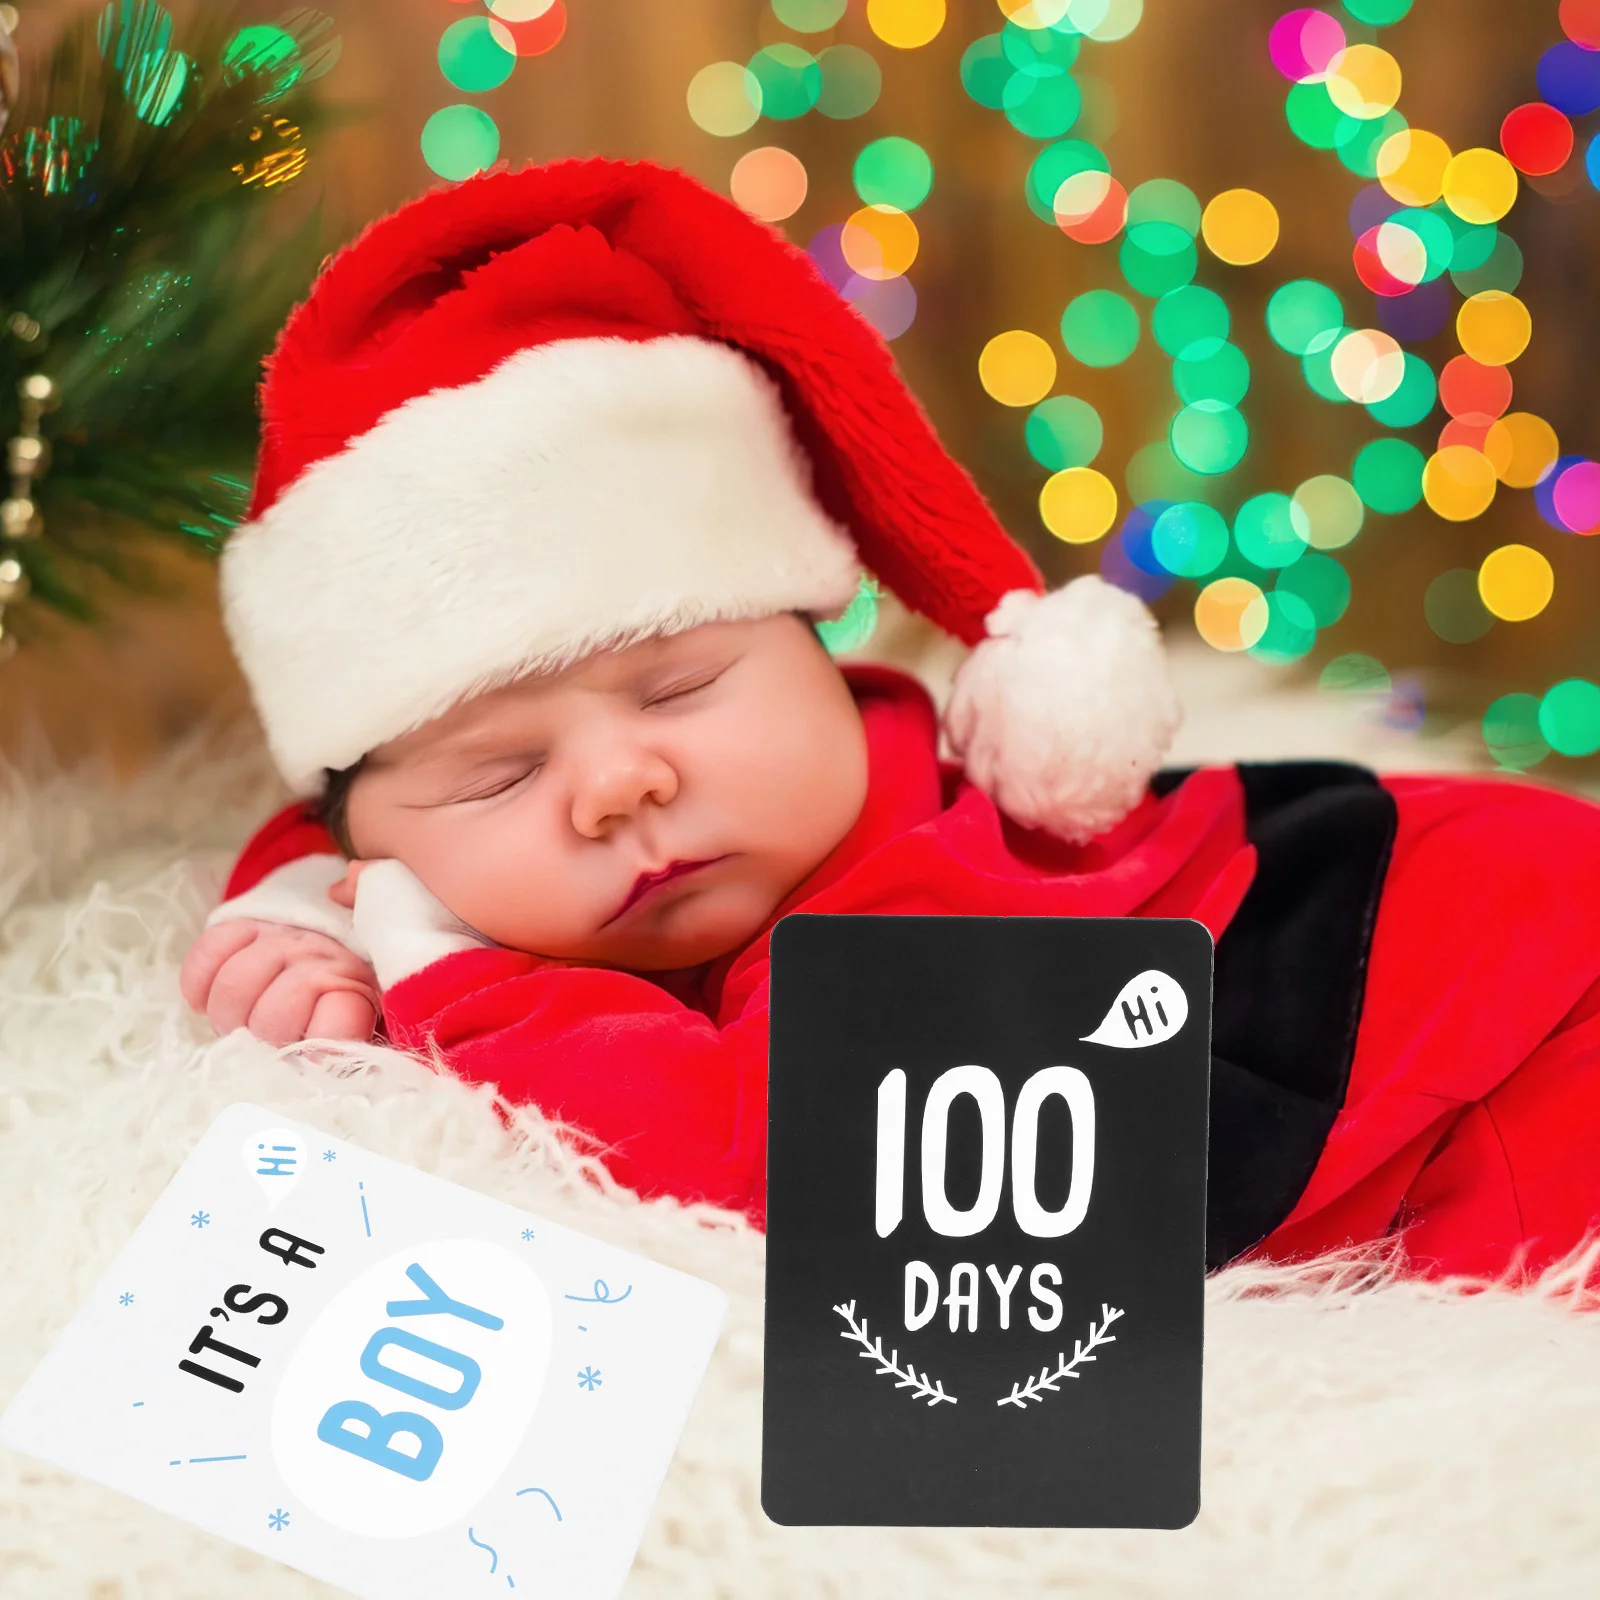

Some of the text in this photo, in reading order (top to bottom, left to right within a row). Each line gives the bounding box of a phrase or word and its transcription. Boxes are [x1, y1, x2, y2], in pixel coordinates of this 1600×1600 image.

[1121, 985, 1170, 1041] Hi
[256, 1142, 298, 1177] Hi
[875, 1065, 1096, 1238] 100
[178, 1226, 326, 1394] IT'S A
[904, 1261, 1064, 1333] DAYS
[317, 1262, 505, 1483] BOY
